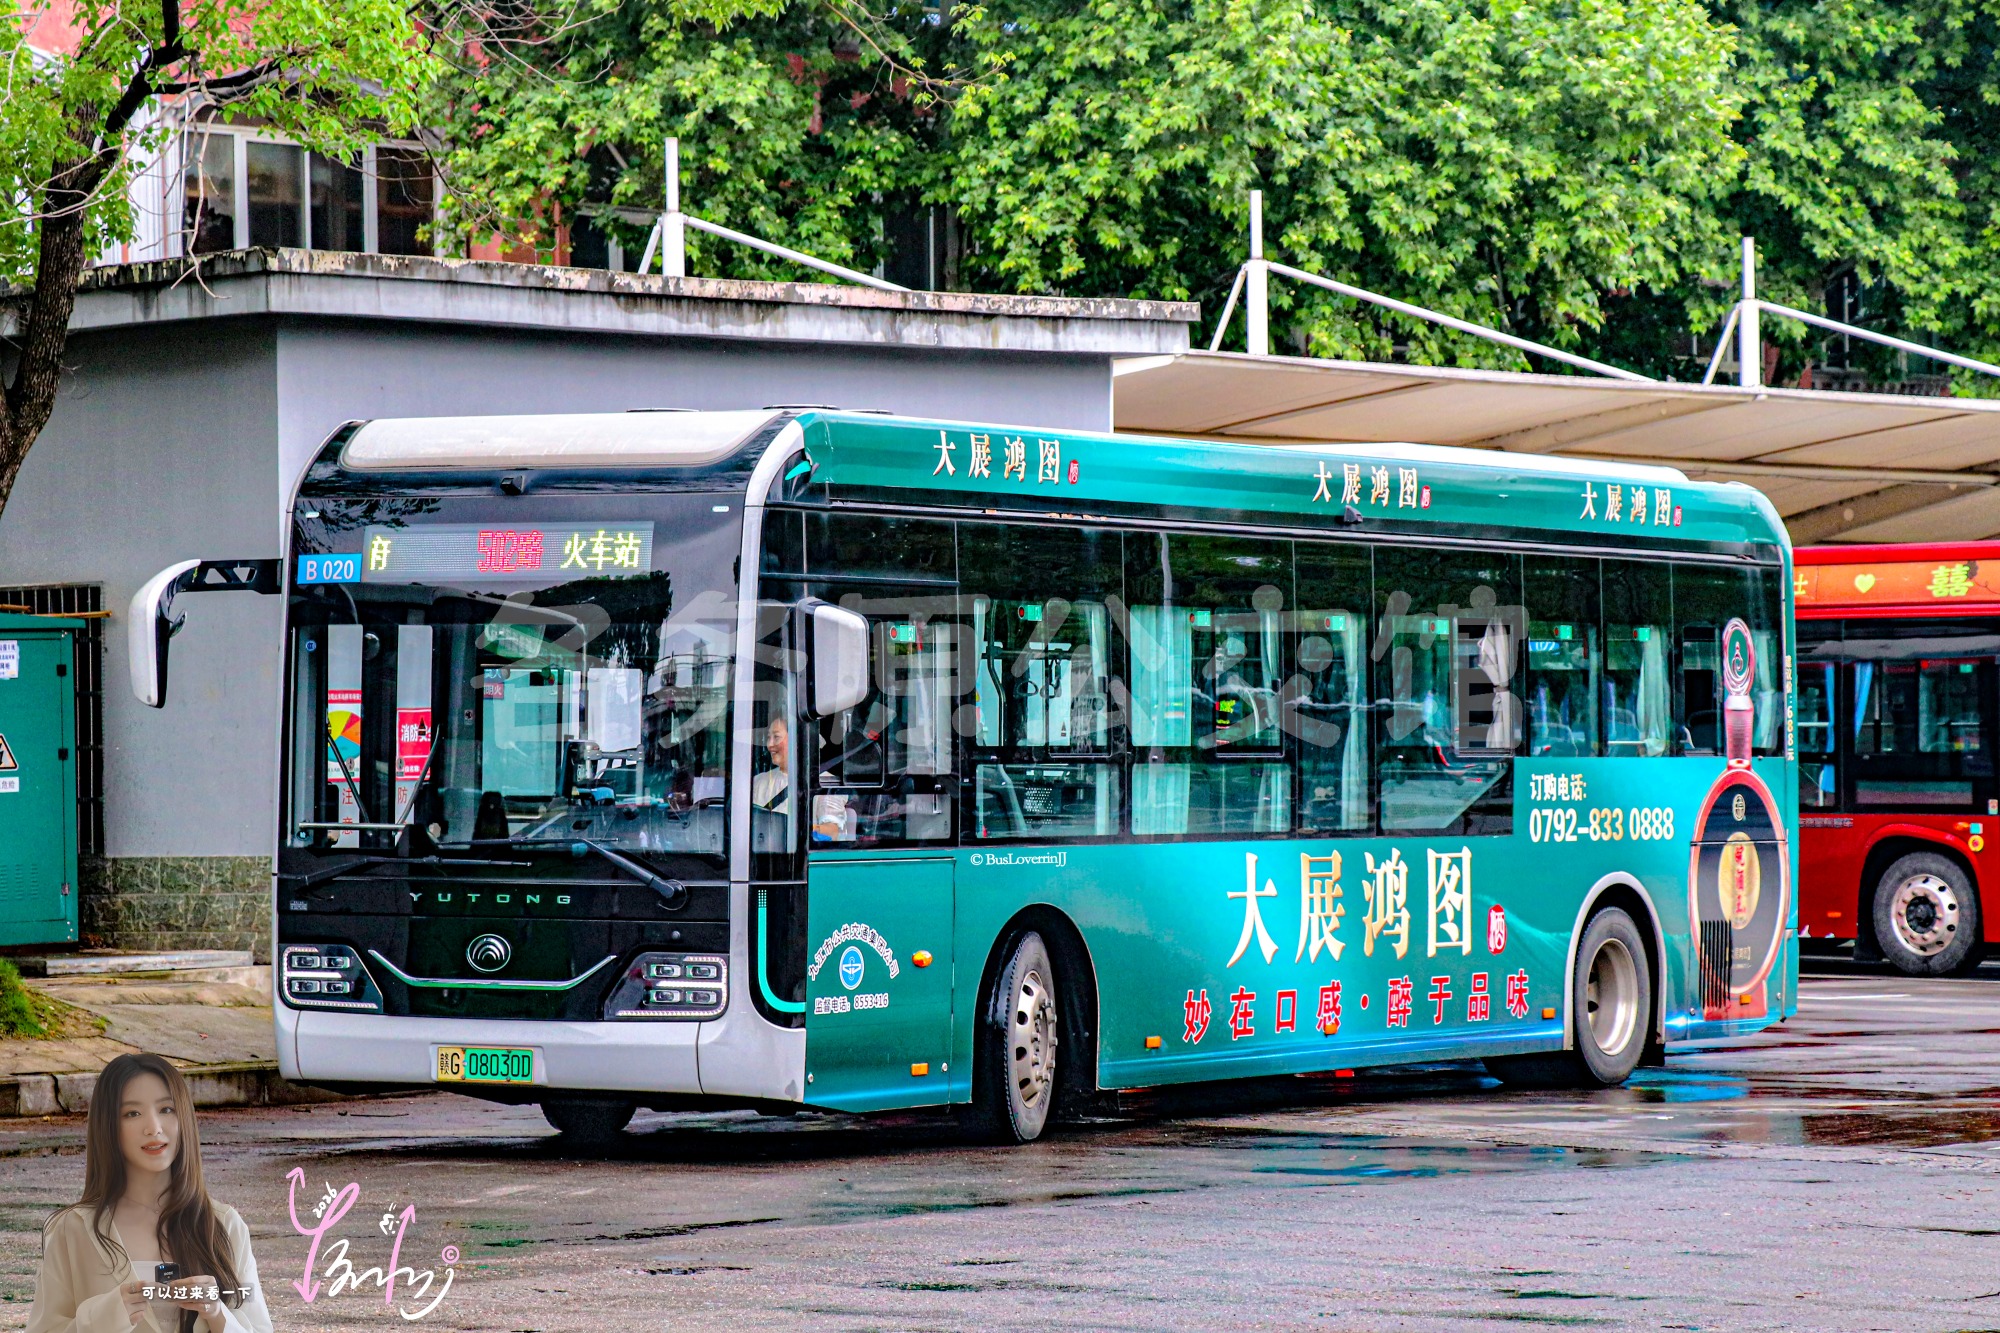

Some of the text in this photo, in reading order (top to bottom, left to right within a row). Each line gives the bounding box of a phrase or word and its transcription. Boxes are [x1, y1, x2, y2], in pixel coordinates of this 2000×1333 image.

[933, 430, 1060, 485] 大展鸿图
[1312, 460, 1418, 510] 大展鸿图
[1580, 481, 1670, 527] 大展鸿图
[306, 560, 354, 580] B 020
[560, 530, 642, 570] 火车站
[1529, 807, 1674, 842] 0792-833 0888
[409, 892, 571, 905] YUTONG
[1226, 846, 1472, 967] 大展鸿图
[808, 922, 899, 981] 九江市公共交通集团公司
[853, 993, 889, 1009] 8553416
